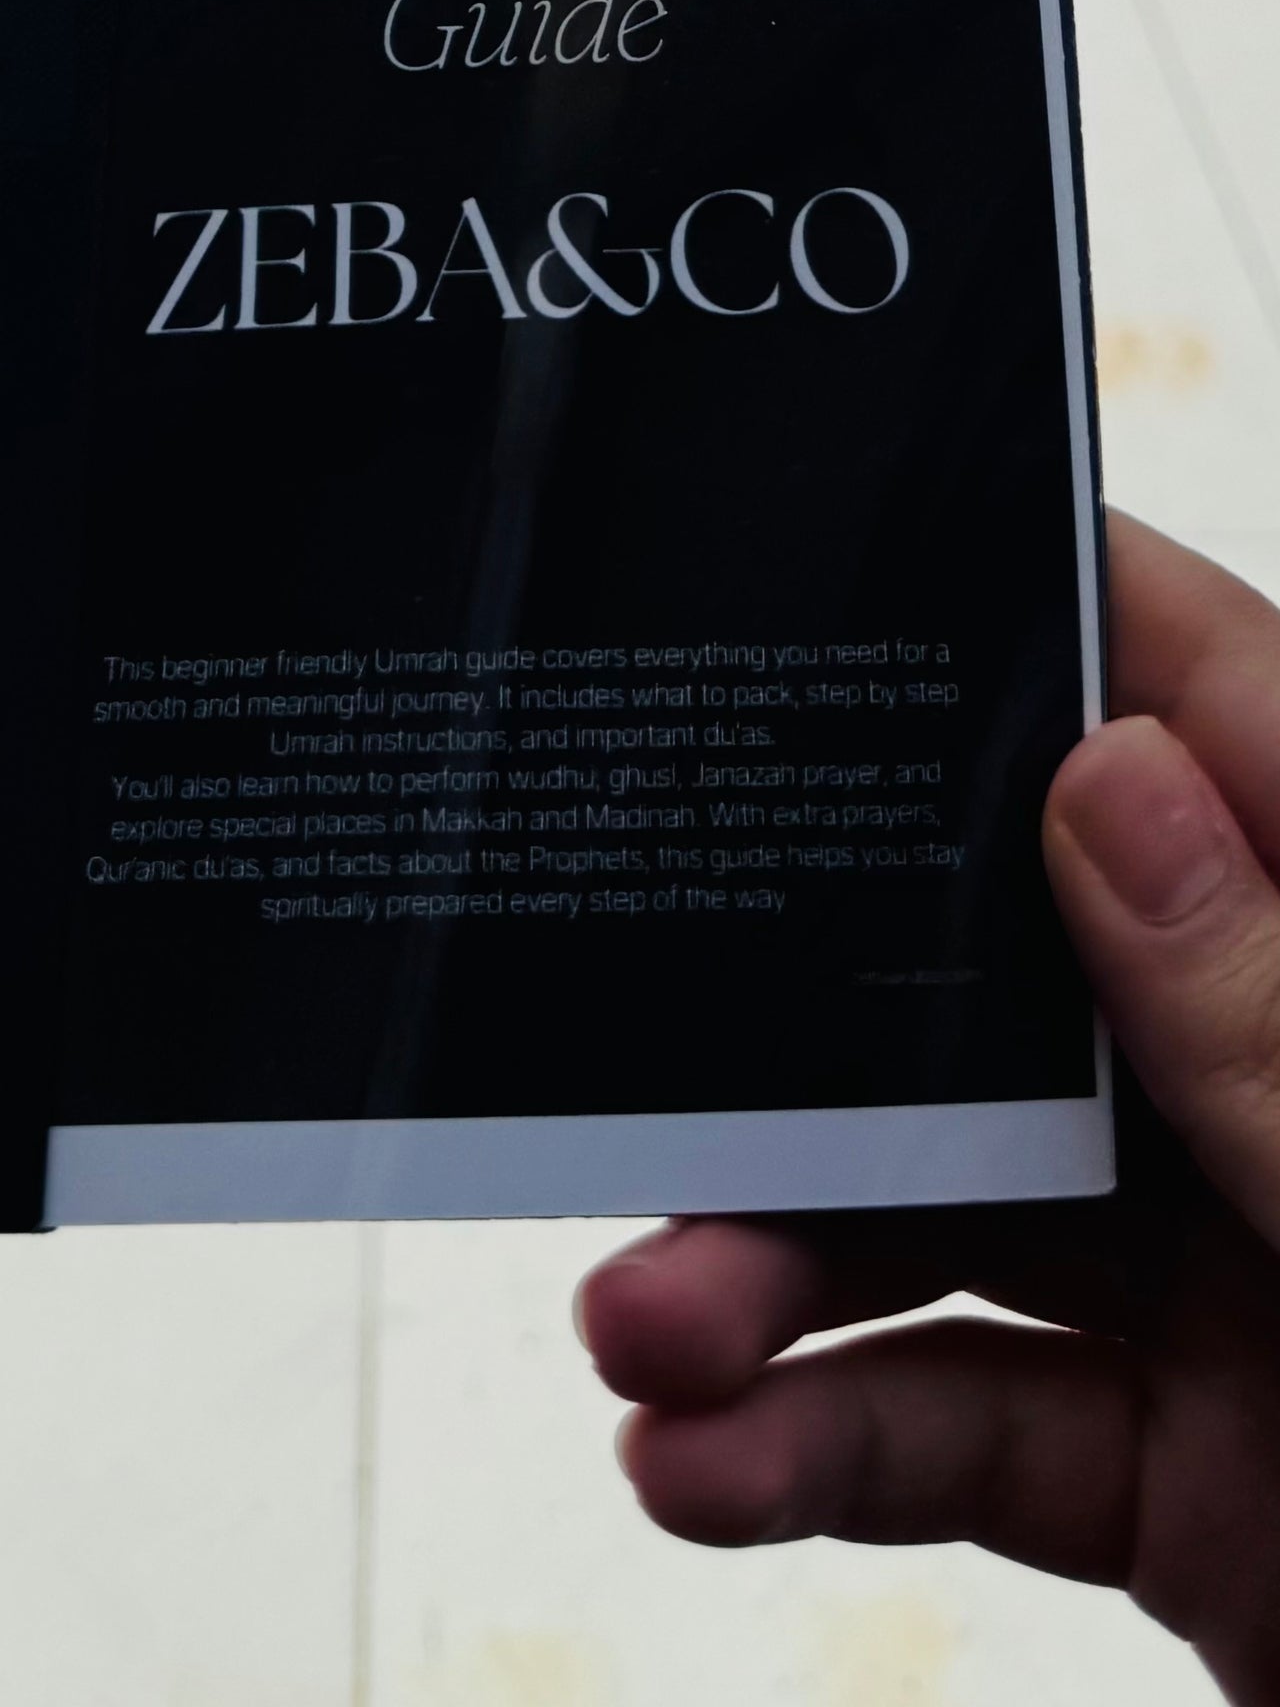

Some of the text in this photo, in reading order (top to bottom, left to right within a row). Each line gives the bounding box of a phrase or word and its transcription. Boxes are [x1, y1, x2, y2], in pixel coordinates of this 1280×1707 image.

[145, 187, 910, 336] ZEBA&CO
[104, 637, 951, 686] This beginner friendly Umrah guide covers everything you need for a
[93, 695, 186, 723] smooth
[193, 691, 240, 718] and
[248, 686, 384, 720] meaningful
[499, 684, 512, 708] It
[520, 684, 624, 709] includes
[632, 683, 694, 707] what
[701, 683, 725, 706] to
[733, 680, 799, 710] pack,
[805, 681, 861, 709] step
[869, 680, 897, 709] by
[904, 682, 960, 708] step
[270, 728, 354, 756] Umrah
[362, 726, 512, 753] instructions,
[520, 725, 568, 750] and
[576, 723, 696, 753] important
[180, 772, 231, 799] also
[238, 770, 299, 796] learn
[306, 769, 360, 794] how
[368, 770, 393, 793] to
[400, 764, 499, 797] perform
[609, 762, 682, 796] ghusl,
[691, 760, 795, 788] Janazah
[803, 762, 888, 790] prayer,
[895, 758, 942, 784] and
[111, 816, 204, 845] explore
[209, 812, 297, 842] special
[304, 811, 386, 842] places
[394, 807, 414, 833] in
[422, 806, 523, 833] Makkah
[529, 805, 577, 831] and
[708, 801, 765, 827] With
[773, 802, 837, 826] extra
[272, 849, 320, 877] and
[328, 848, 392, 877] facts
[399, 849, 471, 875] about
[481, 847, 521, 873] the
[529, 844, 650, 875] Prophets,
[657, 843, 703, 870] this
[709, 844, 781, 875] guide
[787, 843, 854, 871] helps
[861, 845, 907, 871] you
[913, 842, 966, 871] stay
[260, 892, 378, 924] spiritually
[385, 888, 503, 921] prepared
[510, 891, 583, 920] every
[589, 889, 646, 917] step
[653, 885, 678, 912] of
[685, 885, 727, 911] the
